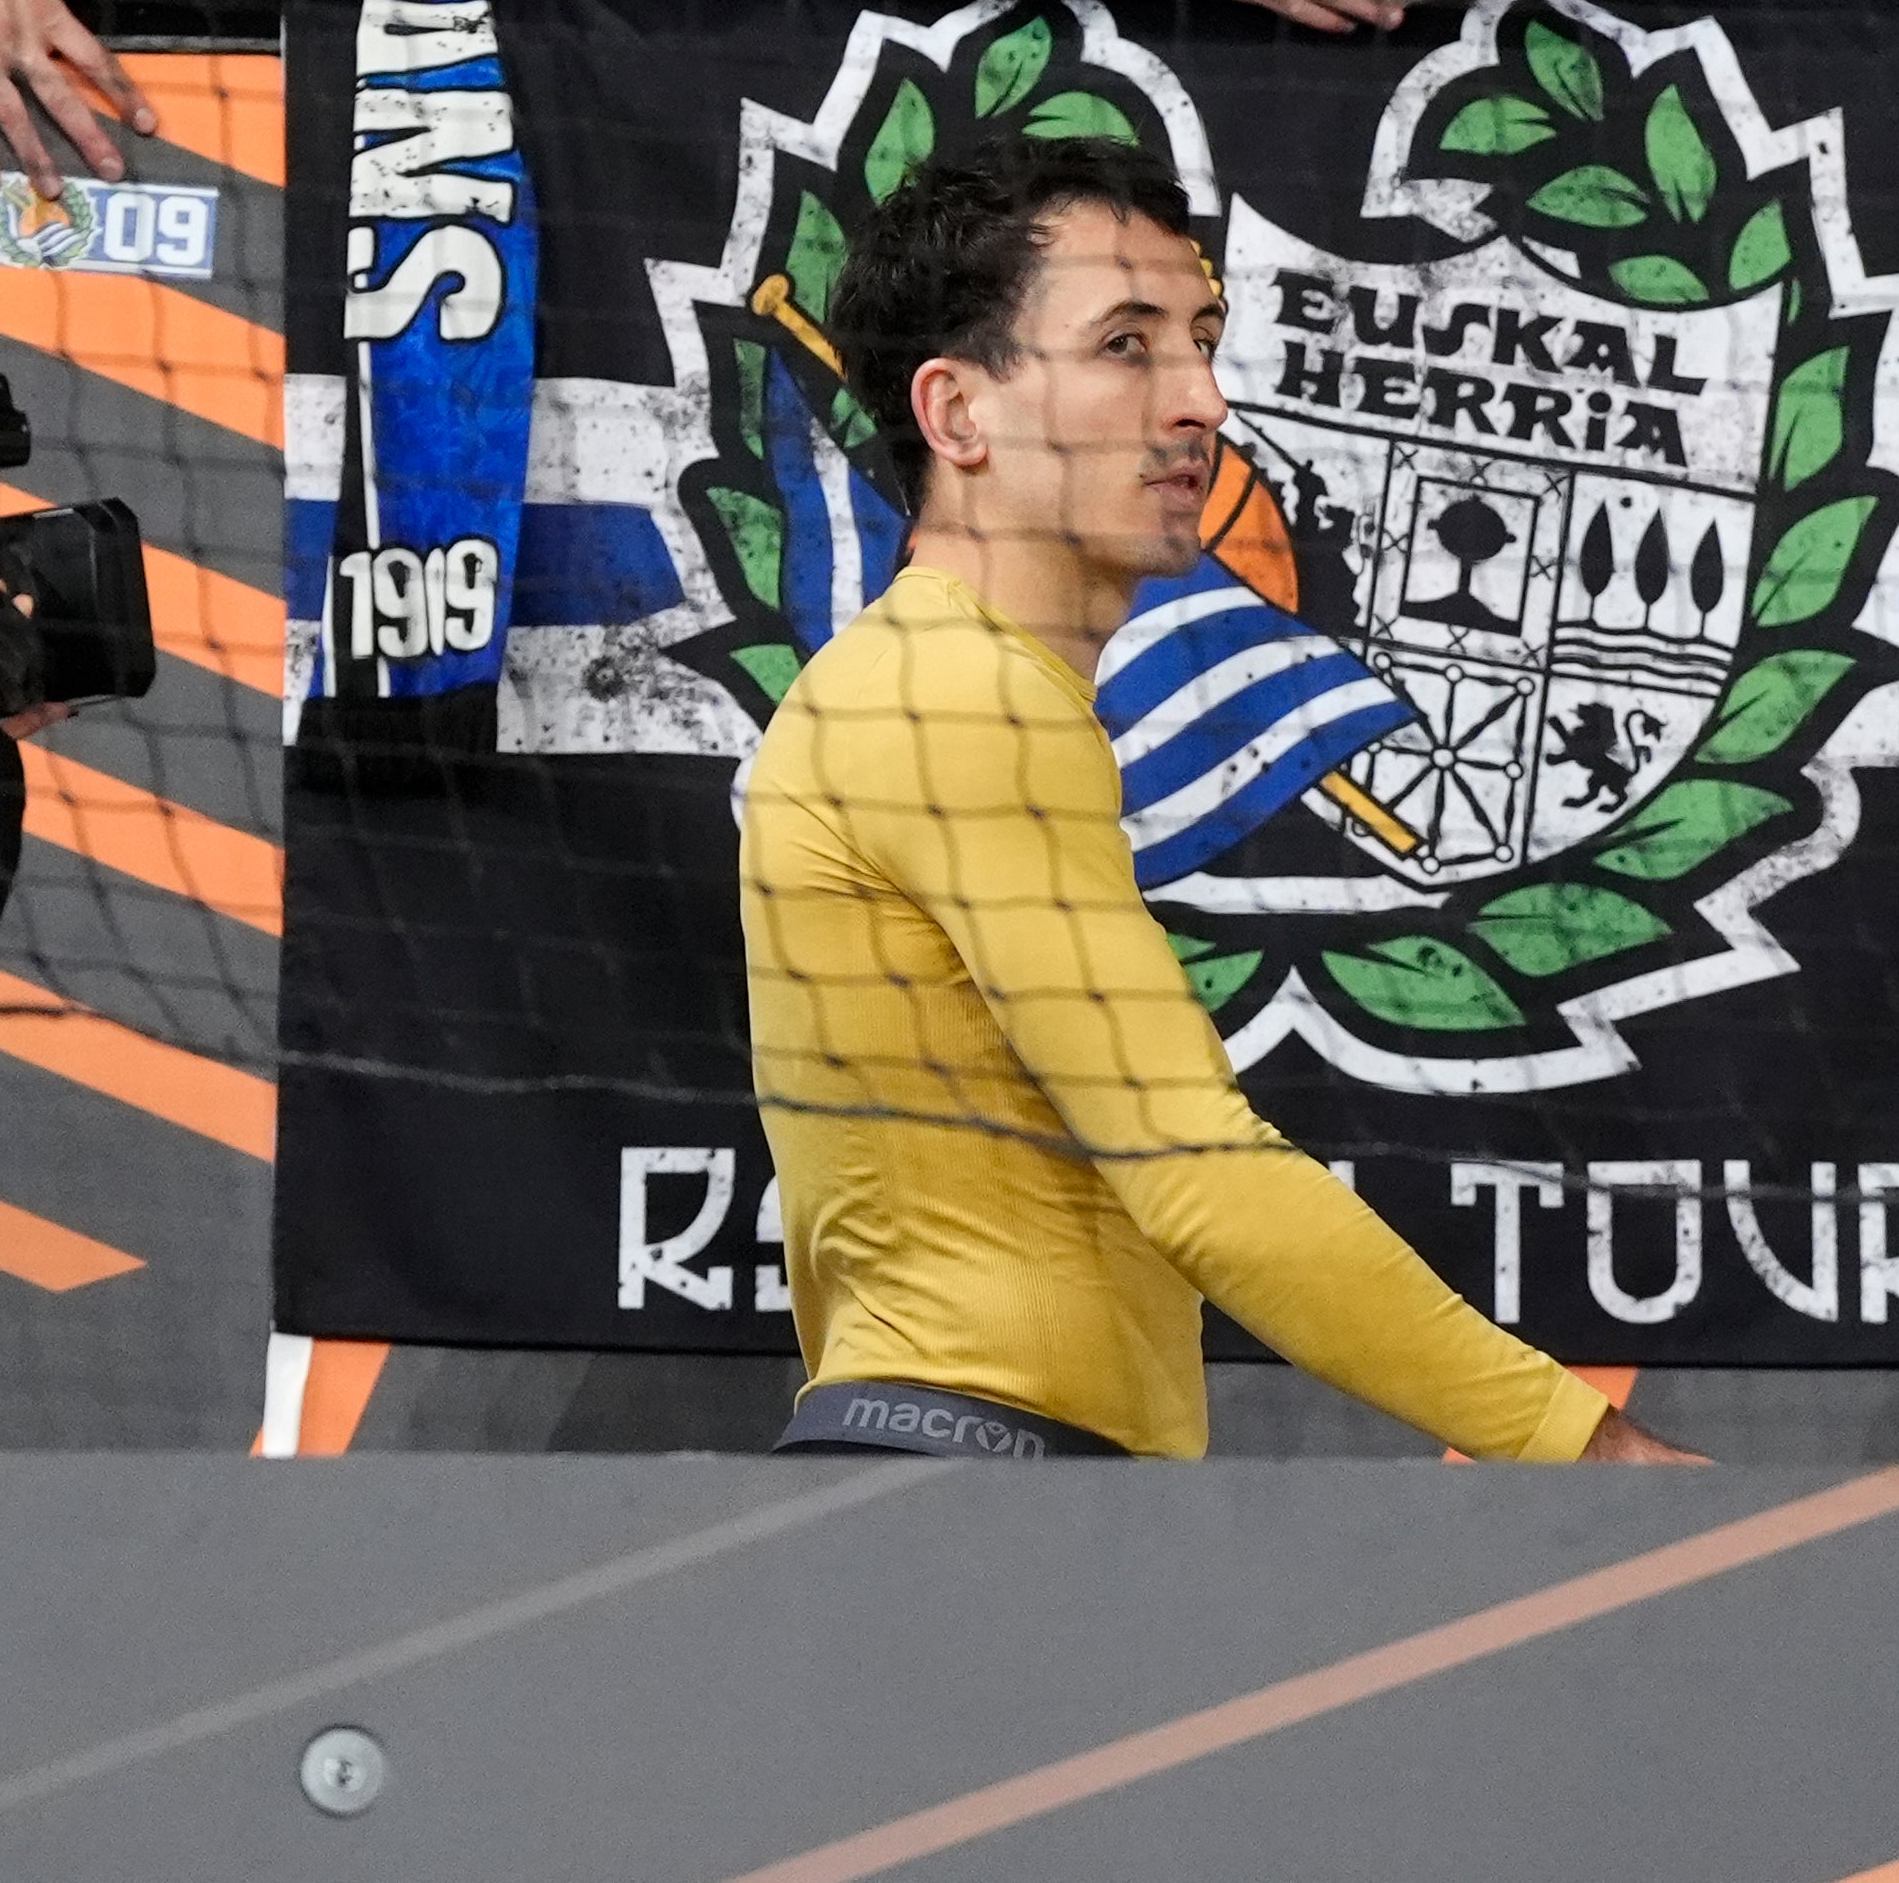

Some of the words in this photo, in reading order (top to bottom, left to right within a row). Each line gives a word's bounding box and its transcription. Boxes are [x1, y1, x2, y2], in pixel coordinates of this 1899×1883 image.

[102, 191, 209, 266] 09
[1269, 267, 1708, 396] EUSKAL
[339, 538, 498, 660] 1919
[841, 1397, 1046, 1457] macron
